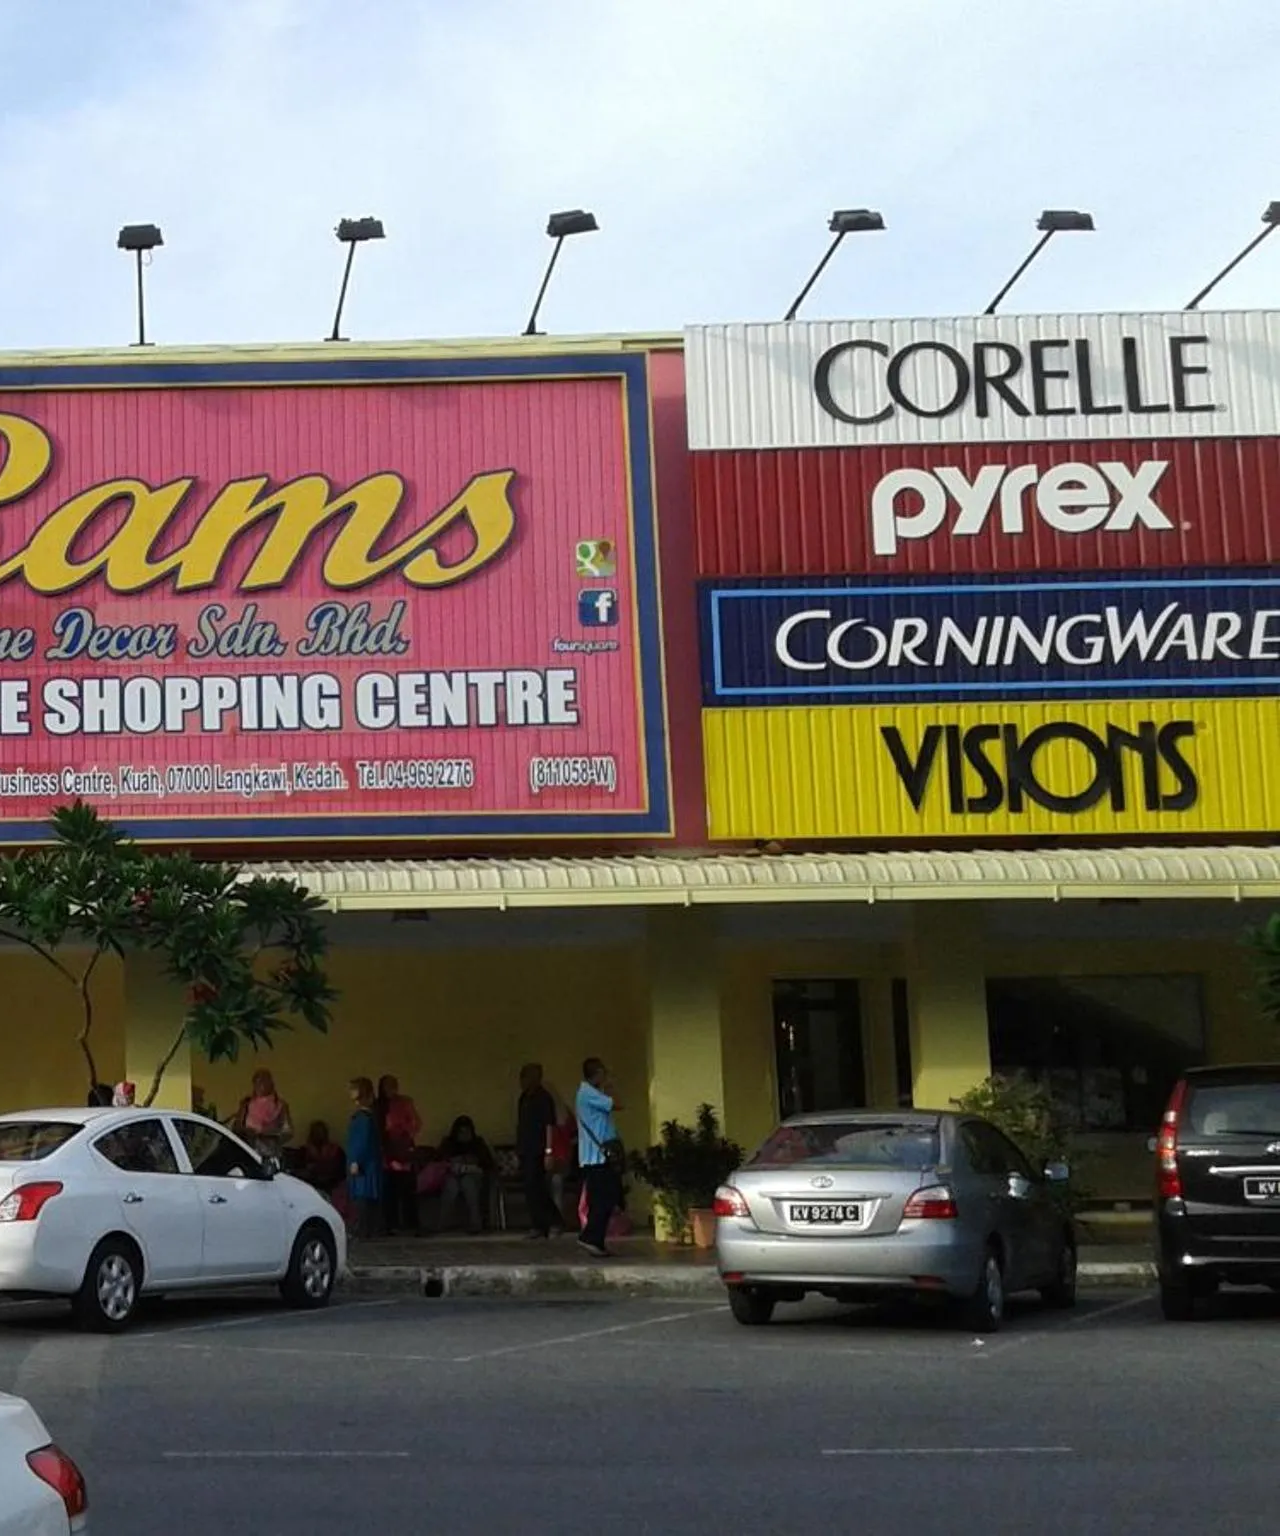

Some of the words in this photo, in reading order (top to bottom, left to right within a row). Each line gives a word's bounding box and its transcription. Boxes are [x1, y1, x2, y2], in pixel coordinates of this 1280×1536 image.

[813, 335, 1216, 425] CORELLE
[870, 459, 1175, 556] pyrex
[45, 606, 178, 663] Decor
[187, 602, 288, 660] Sdn.
[297, 598, 412, 656] Bhd.
[42, 673, 343, 736] SHOPPING
[354, 667, 580, 730] CENTRE
[61, 766, 118, 798] Centre,
[119, 764, 165, 798] Kuah,
[166, 765, 212, 793] 07000
[214, 763, 293, 796] Langkawi,
[880, 720, 1198, 815] VISIONS
[792, 1205, 809, 1220] KV
[811, 1205, 845, 1220] 9274
[846, 1205, 856, 1220] C
